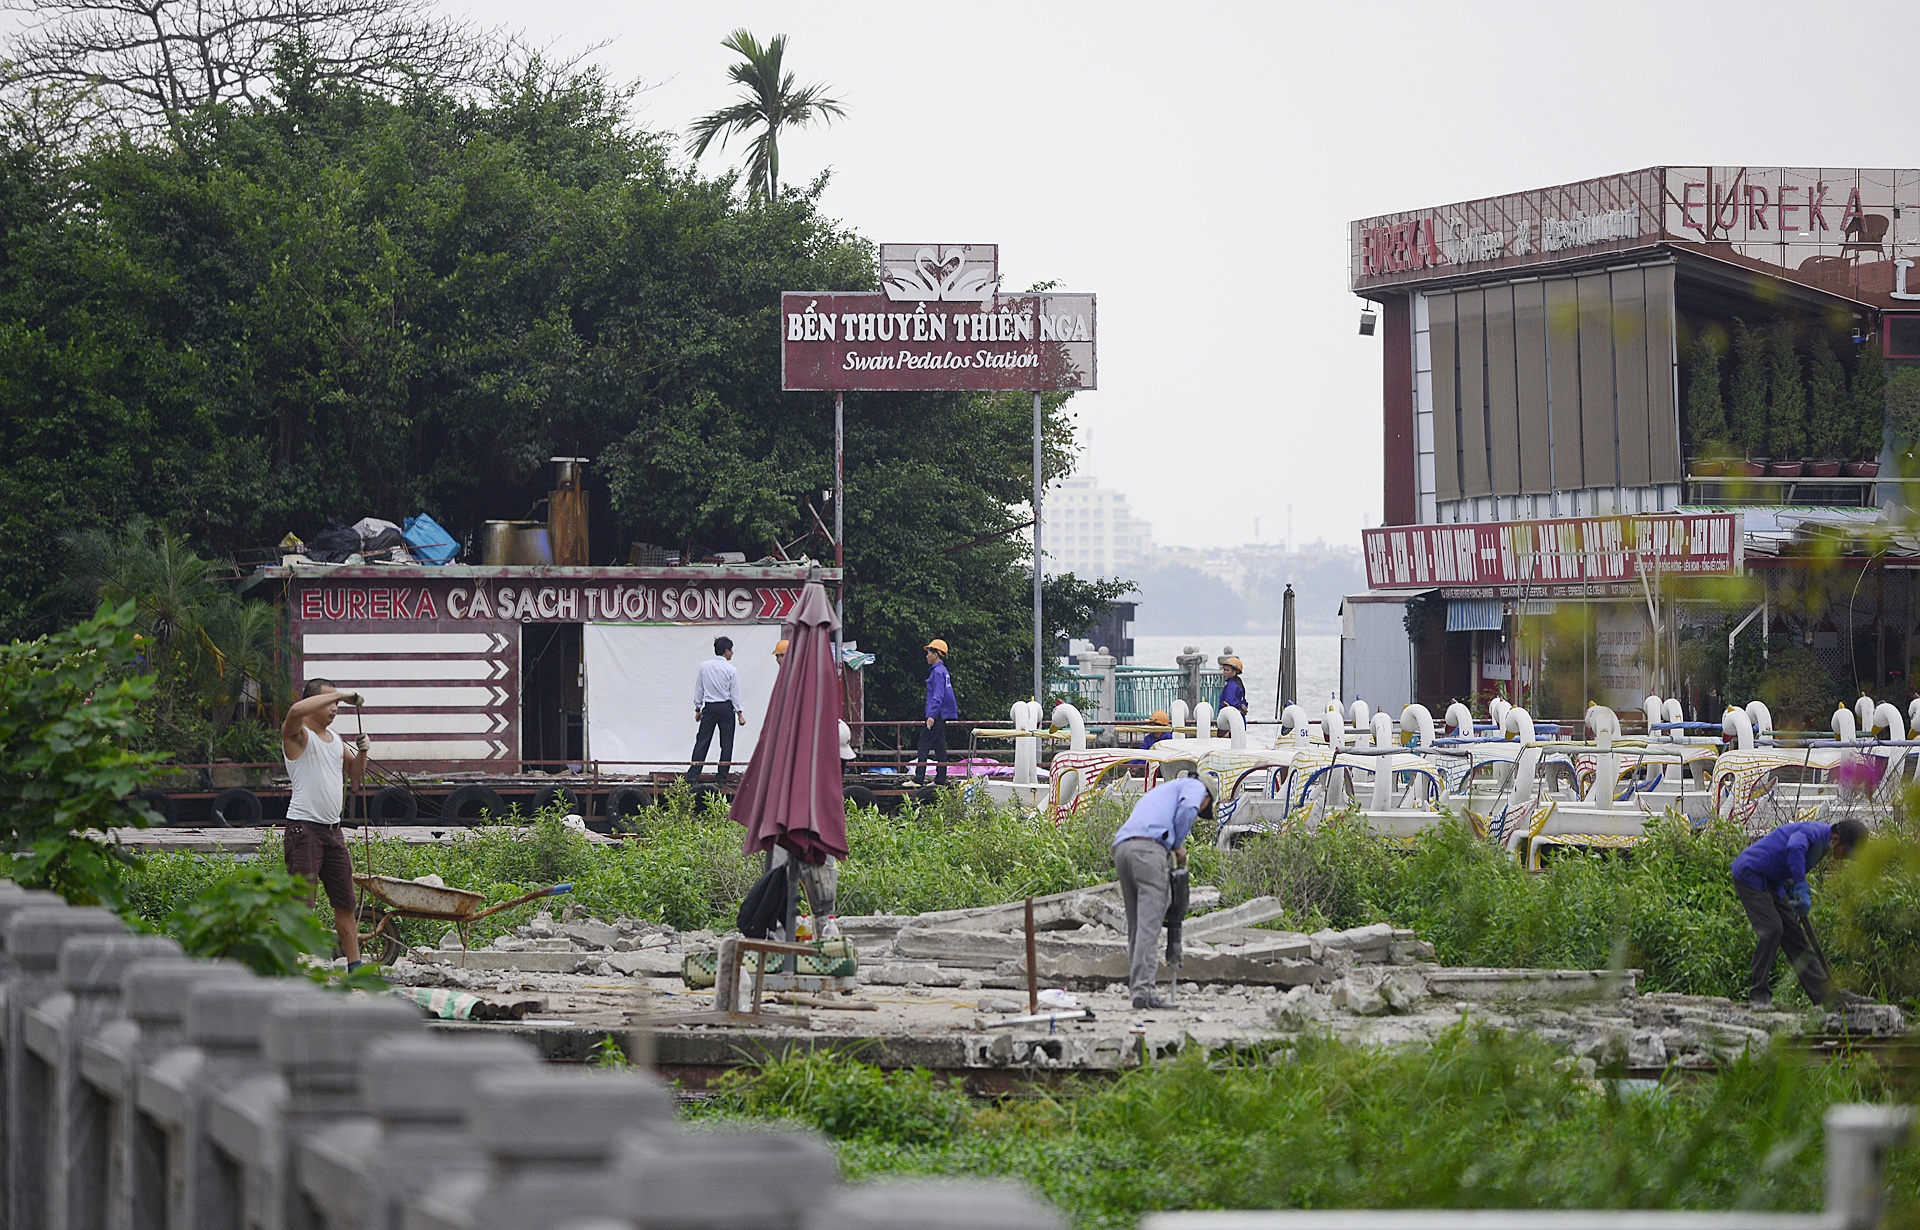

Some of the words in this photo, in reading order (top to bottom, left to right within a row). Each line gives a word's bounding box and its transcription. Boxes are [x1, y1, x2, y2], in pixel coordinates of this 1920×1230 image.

[1682, 182, 1868, 232] EUREKA
[1361, 217, 1437, 277] EUREKA
[787, 300, 837, 341] BẾN
[841, 301, 948, 341] THUYỀN
[952, 305, 1032, 341] THIÊN
[1039, 313, 1090, 342] NGA
[842, 351, 896, 371] Swan
[896, 352, 971, 370] Pedalos
[972, 350, 1040, 369] Station
[301, 588, 438, 620] EUREKA
[446, 578, 495, 620] CÁ
[498, 587, 579, 623] SẠCH
[584, 584, 657, 621] TƯƠI
